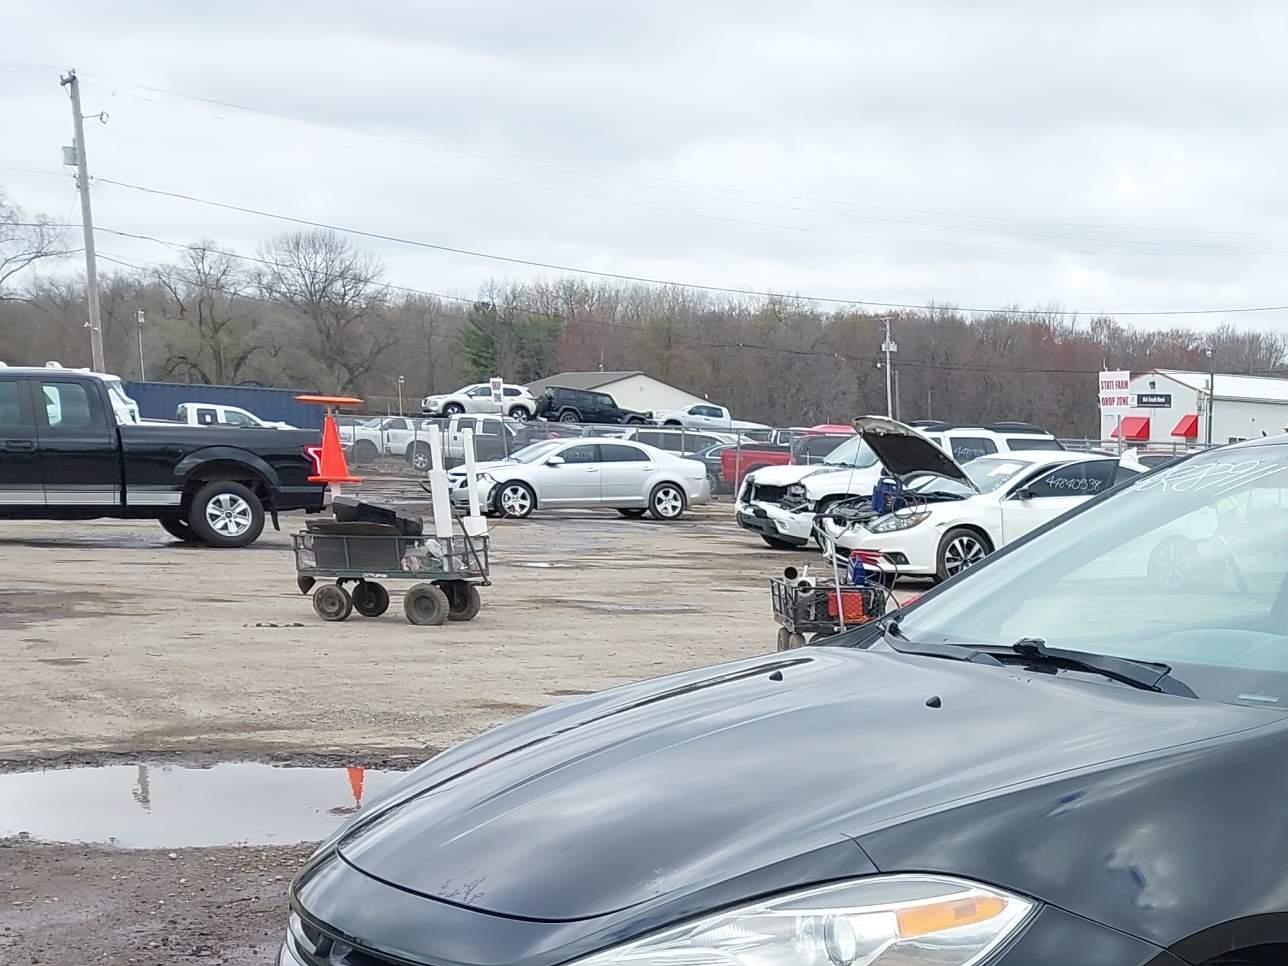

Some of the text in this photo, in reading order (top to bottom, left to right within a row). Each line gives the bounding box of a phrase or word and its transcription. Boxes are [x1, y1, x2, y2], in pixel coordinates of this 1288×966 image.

[1101, 380, 1128, 390] STATE FARM
[1102, 397, 1115, 406] DROP
[1116, 397, 1129, 406] ZONE
